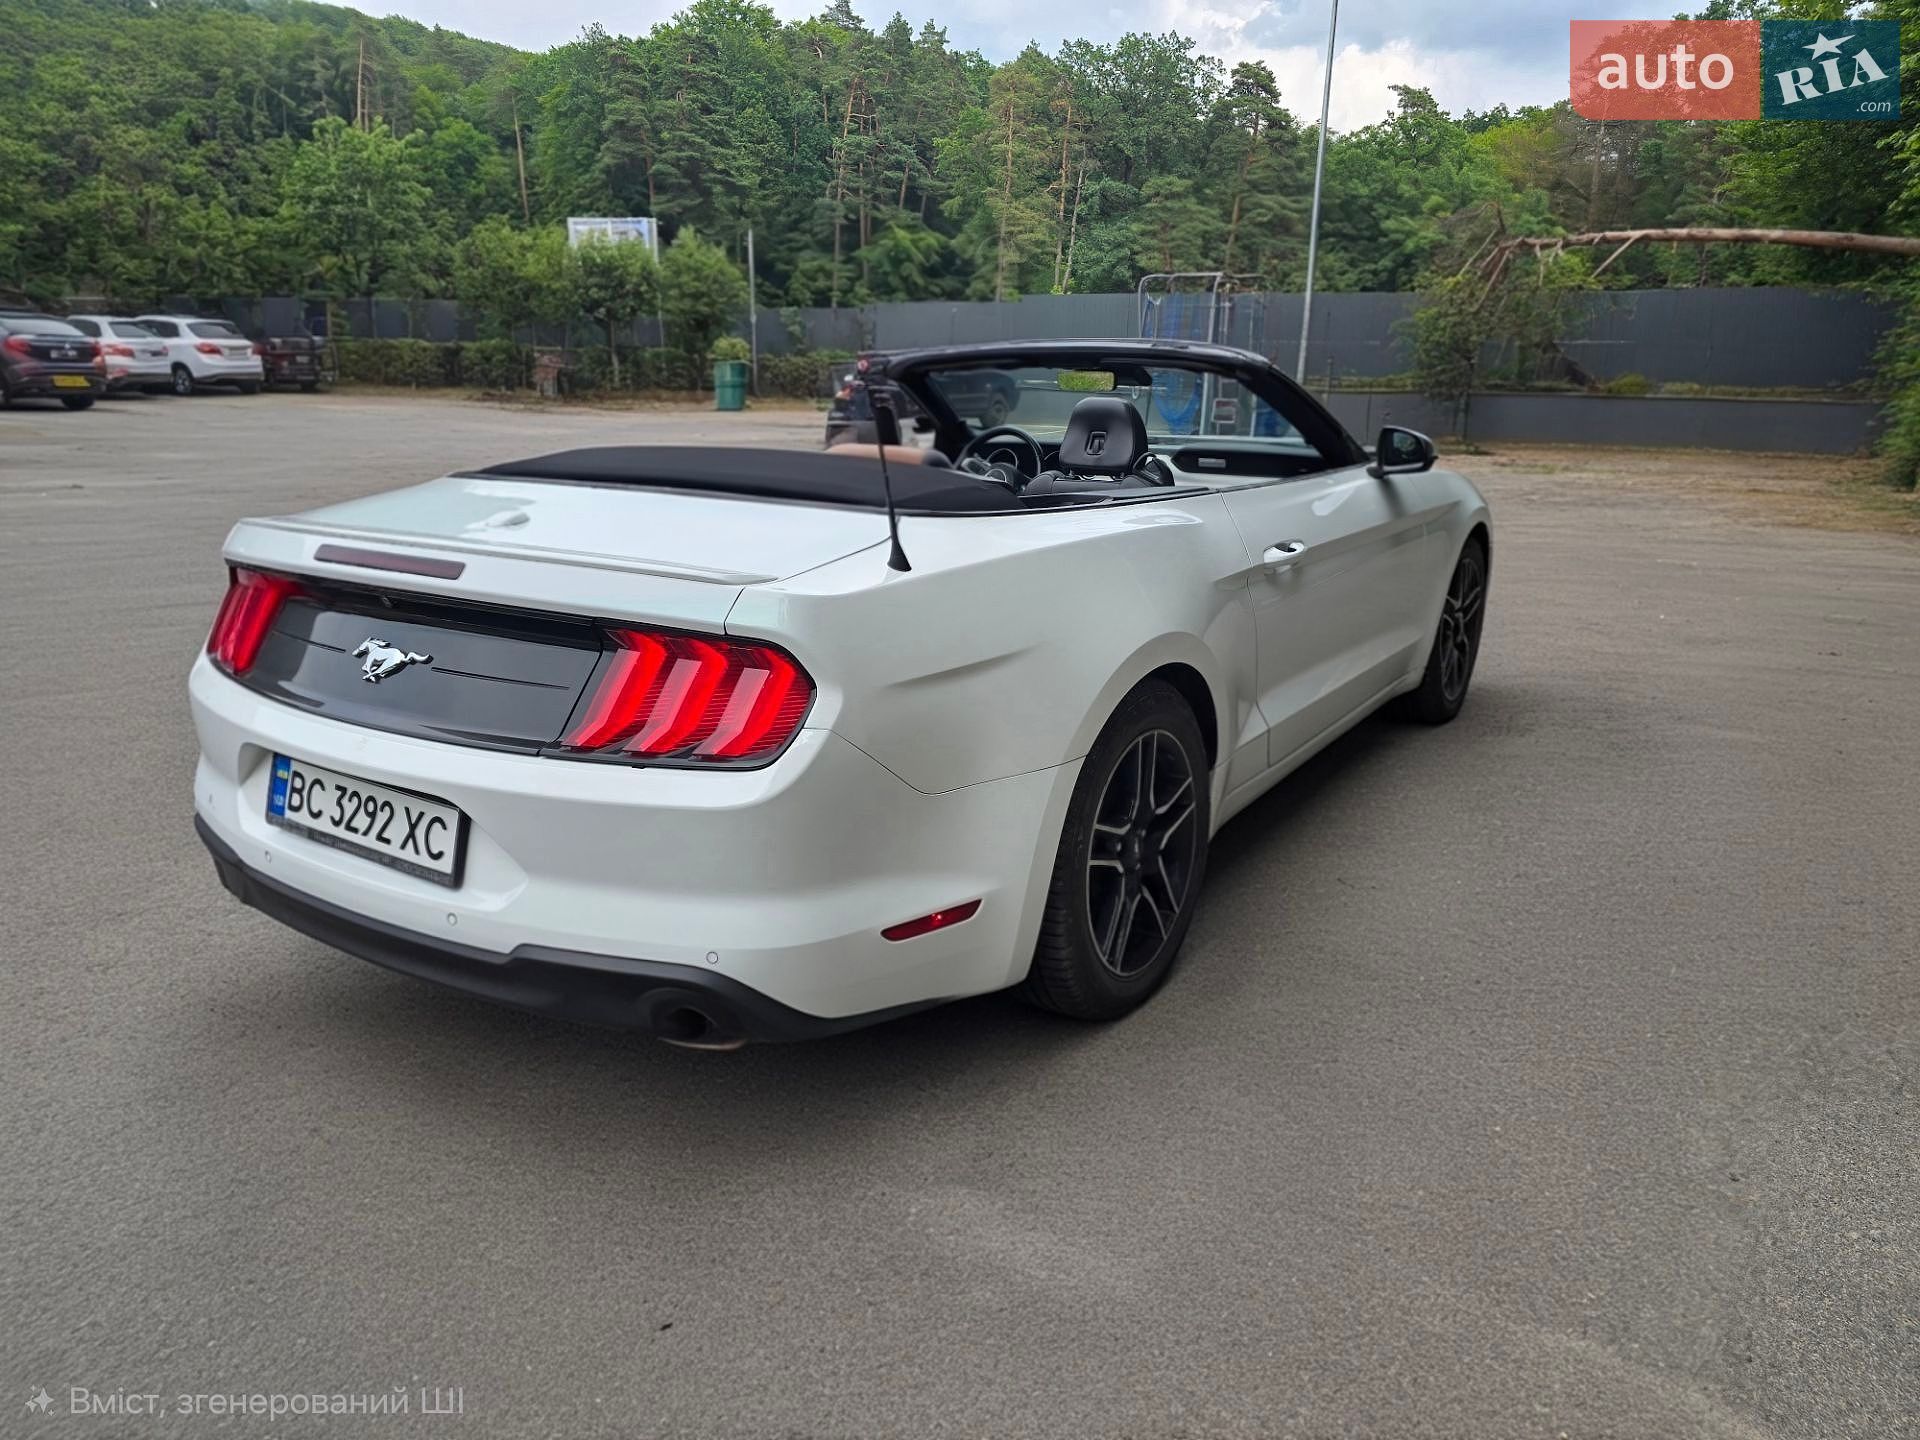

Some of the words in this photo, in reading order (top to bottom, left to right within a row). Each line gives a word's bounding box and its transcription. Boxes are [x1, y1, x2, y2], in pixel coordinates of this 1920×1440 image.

[287, 770, 325, 819] BC
[329, 784, 395, 845] 3292
[400, 806, 447, 860] XC
